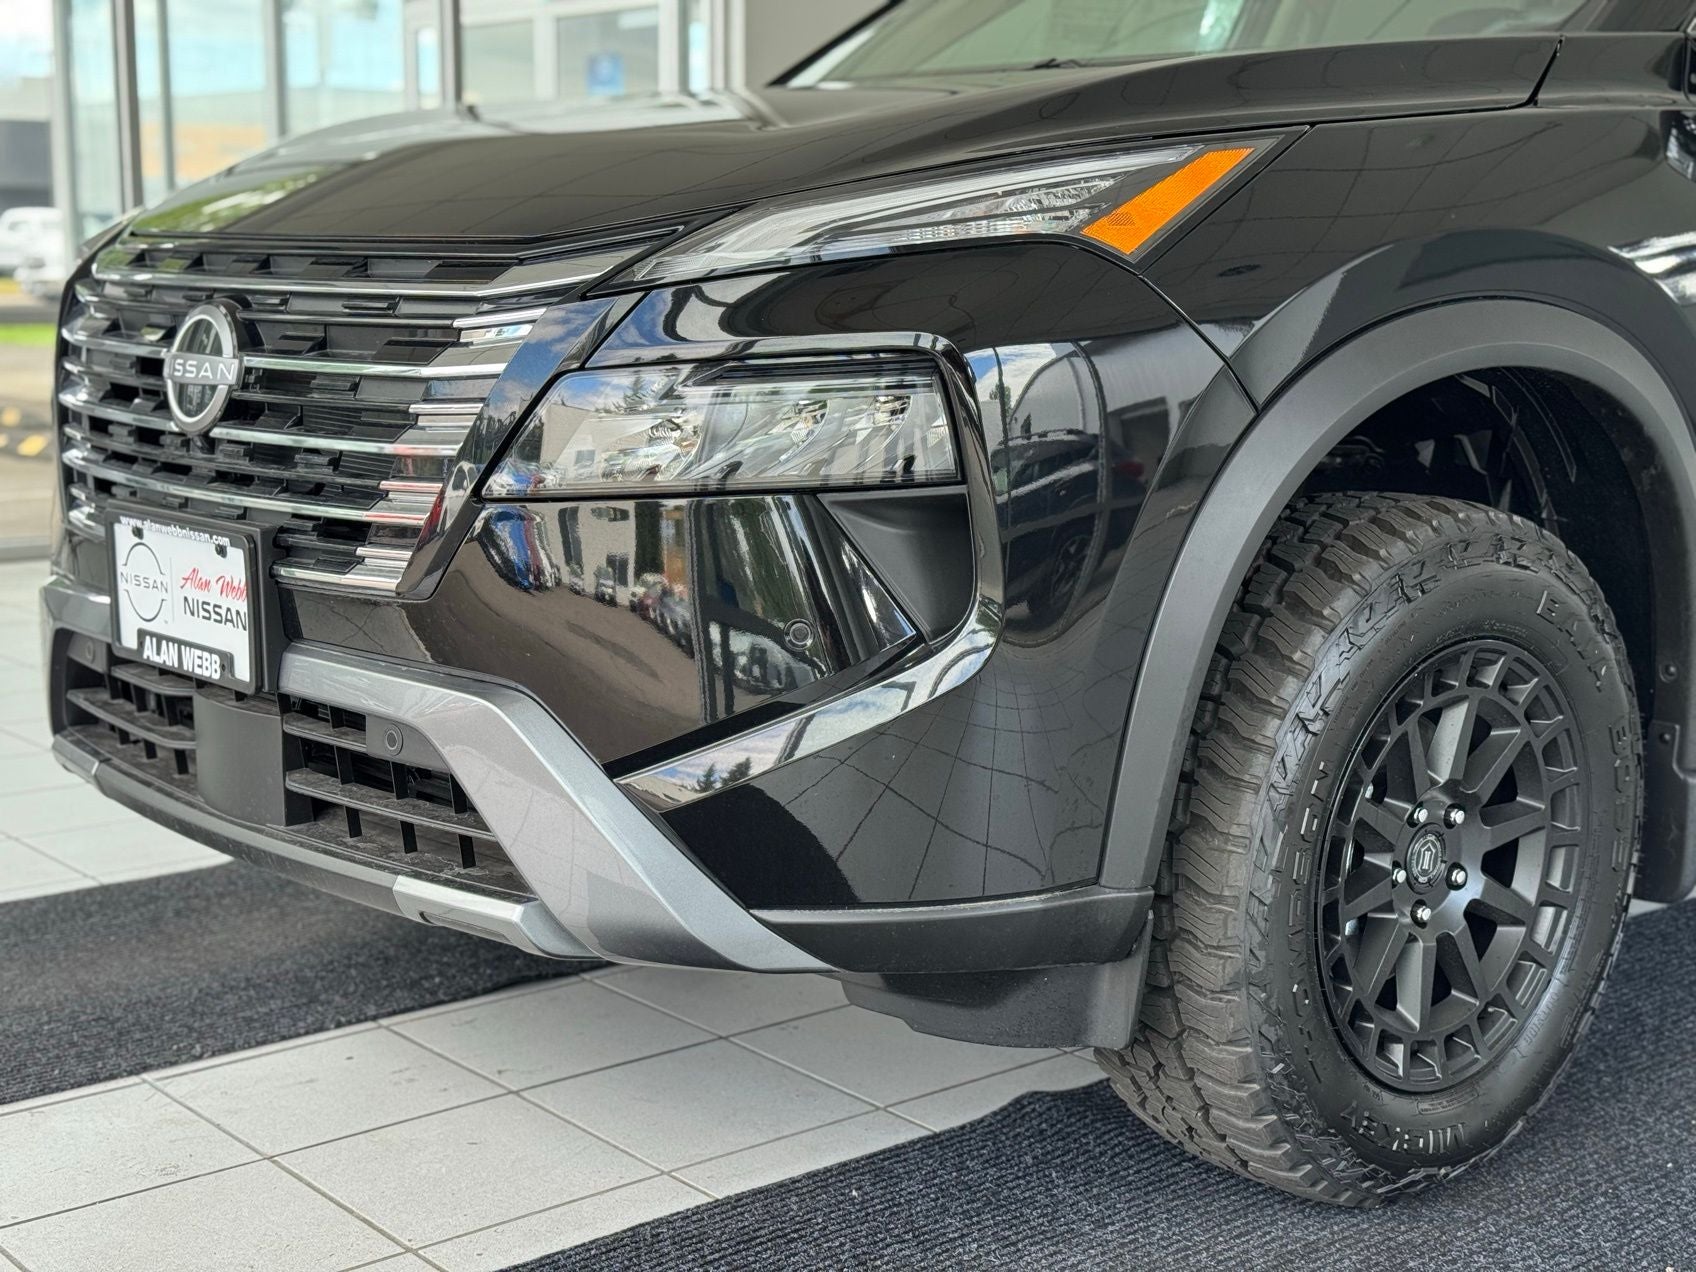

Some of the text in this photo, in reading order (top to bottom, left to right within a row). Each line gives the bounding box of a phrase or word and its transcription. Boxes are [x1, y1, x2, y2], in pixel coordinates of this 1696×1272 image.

[120, 515, 231, 547] www.alanwebbnissan.com
[120, 571, 168, 593] NISSAN
[180, 567, 211, 592] Alan
[183, 595, 247, 631] NISSAN
[143, 635, 221, 680] ALAN WEBB
